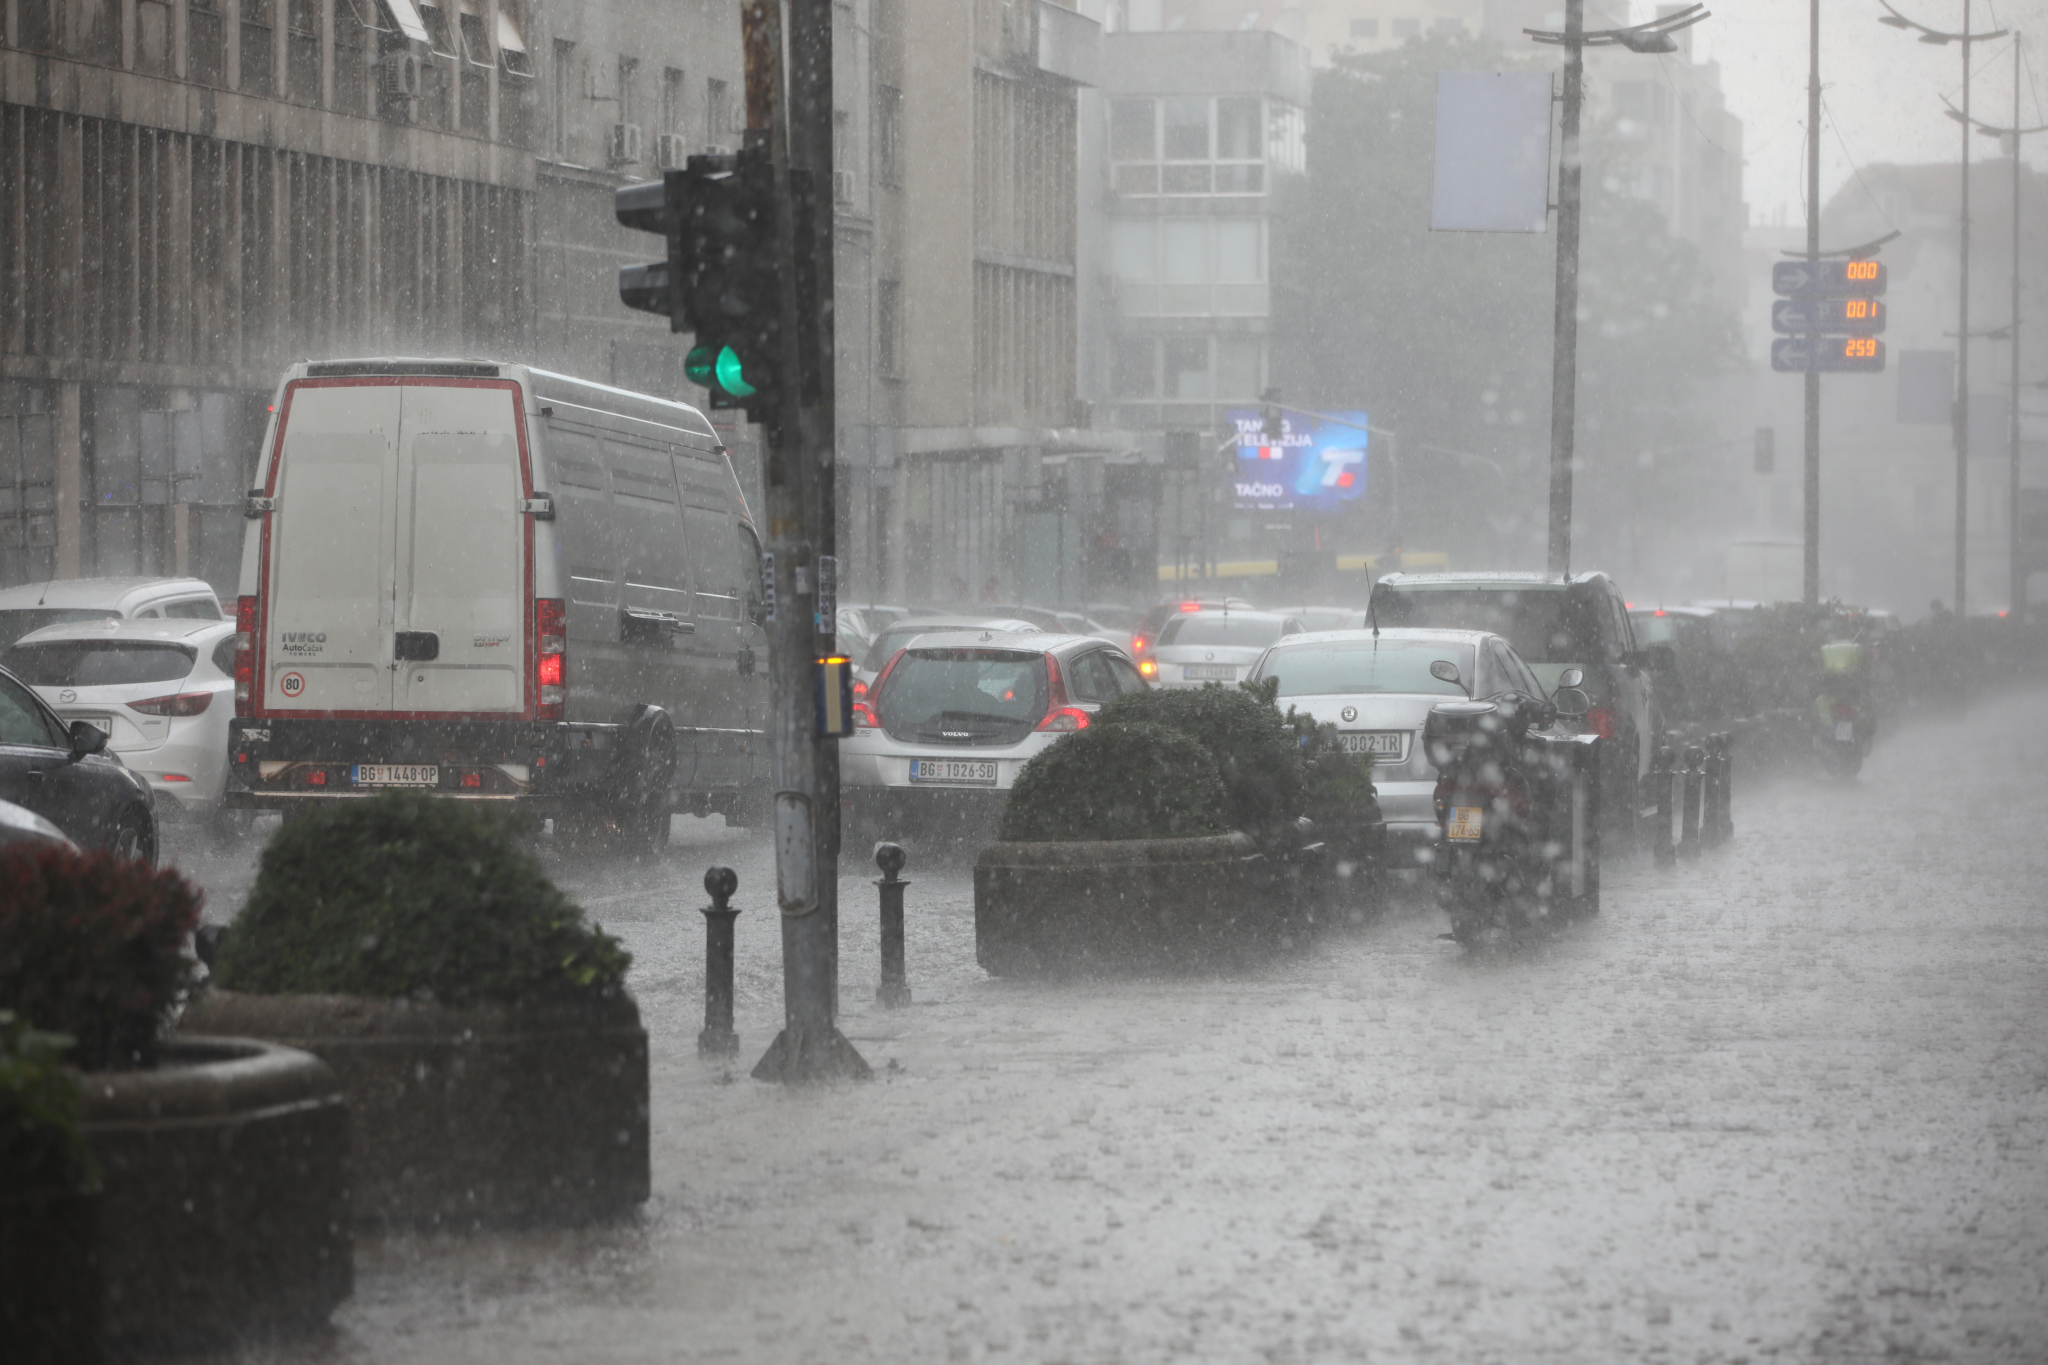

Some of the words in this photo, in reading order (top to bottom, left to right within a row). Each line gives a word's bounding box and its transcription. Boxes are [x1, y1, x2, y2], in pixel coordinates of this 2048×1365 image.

[1847, 262, 1877, 279] 000
[1846, 301, 1876, 318] 001
[1845, 339, 1876, 357] 259
[282, 632, 327, 643] IVECO
[473, 633, 511, 642] DAILY
[285, 678, 300, 690] 80
[360, 766, 376, 781] BG
[920, 763, 936, 777] BG
[1458, 809, 1470, 821] BG
